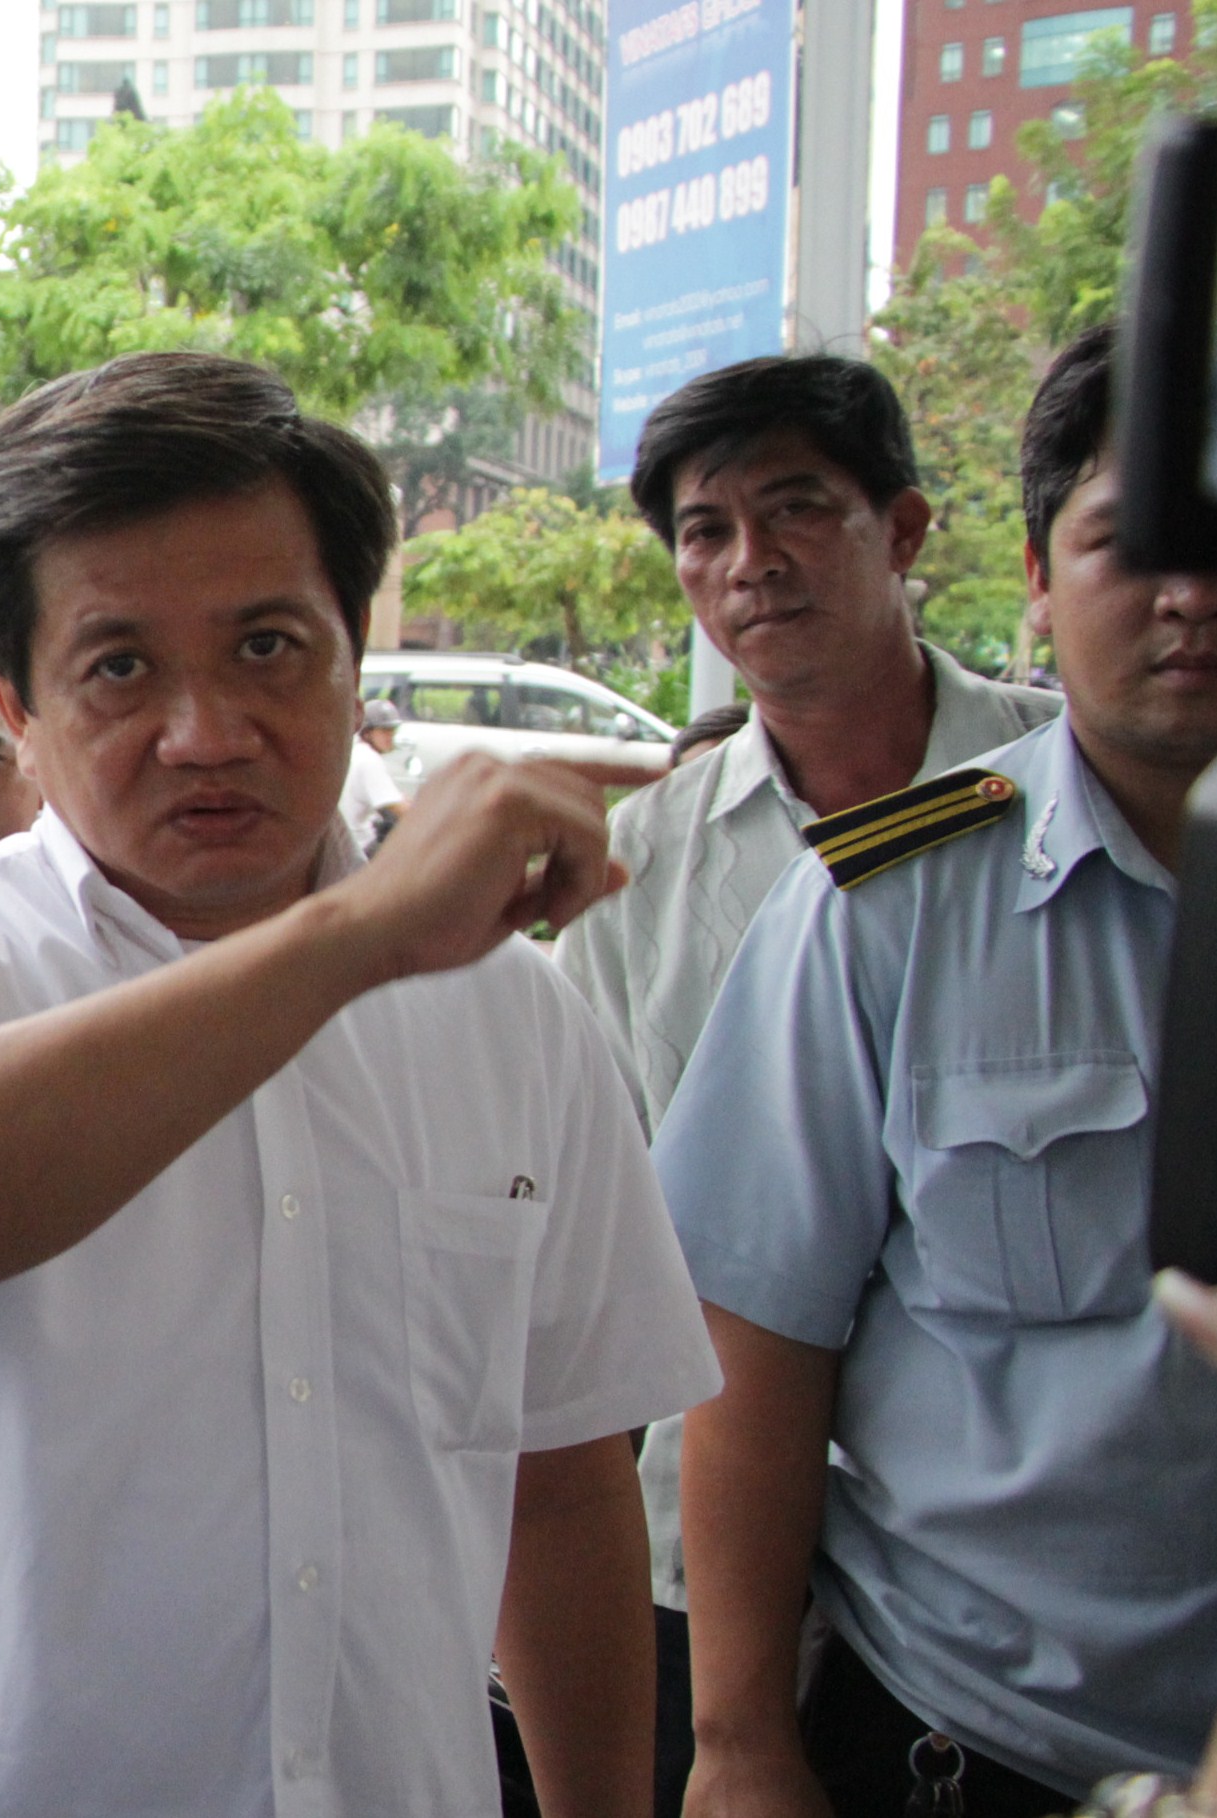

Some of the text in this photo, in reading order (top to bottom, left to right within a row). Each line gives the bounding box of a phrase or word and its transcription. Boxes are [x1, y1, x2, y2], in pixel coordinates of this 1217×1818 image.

[617, 69, 771, 178] 0903 702 689
[671, 173, 716, 234] 440
[719, 154, 769, 222] 899
